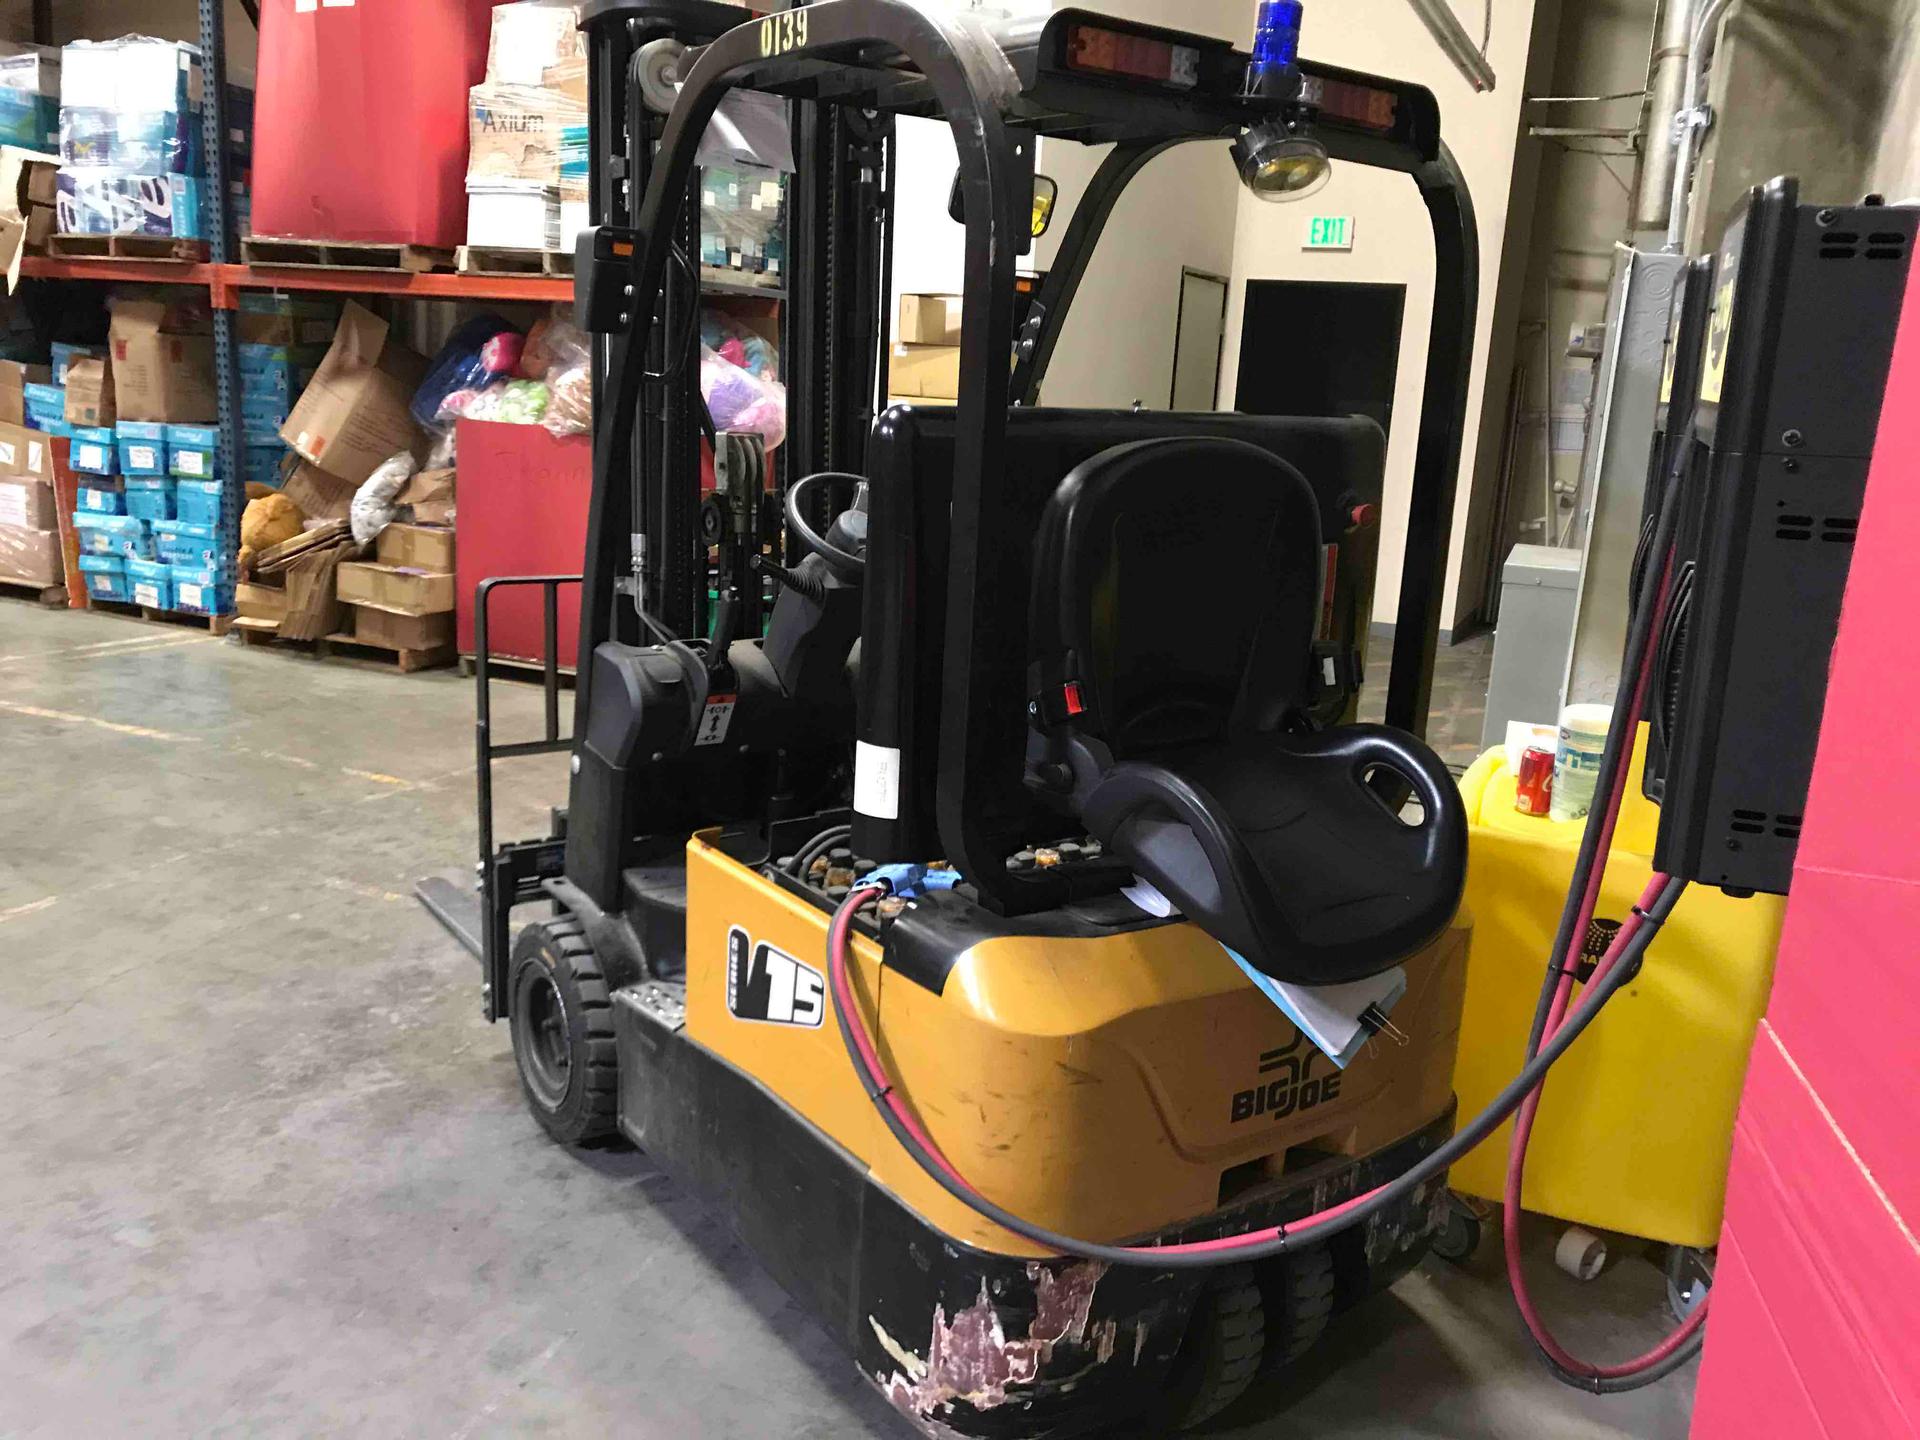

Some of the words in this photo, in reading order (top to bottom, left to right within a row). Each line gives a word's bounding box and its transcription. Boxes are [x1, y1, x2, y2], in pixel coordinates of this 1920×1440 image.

[761, 9, 808, 58] 0139
[483, 109, 544, 133] Axium
[1311, 217, 1346, 245] EXIT
